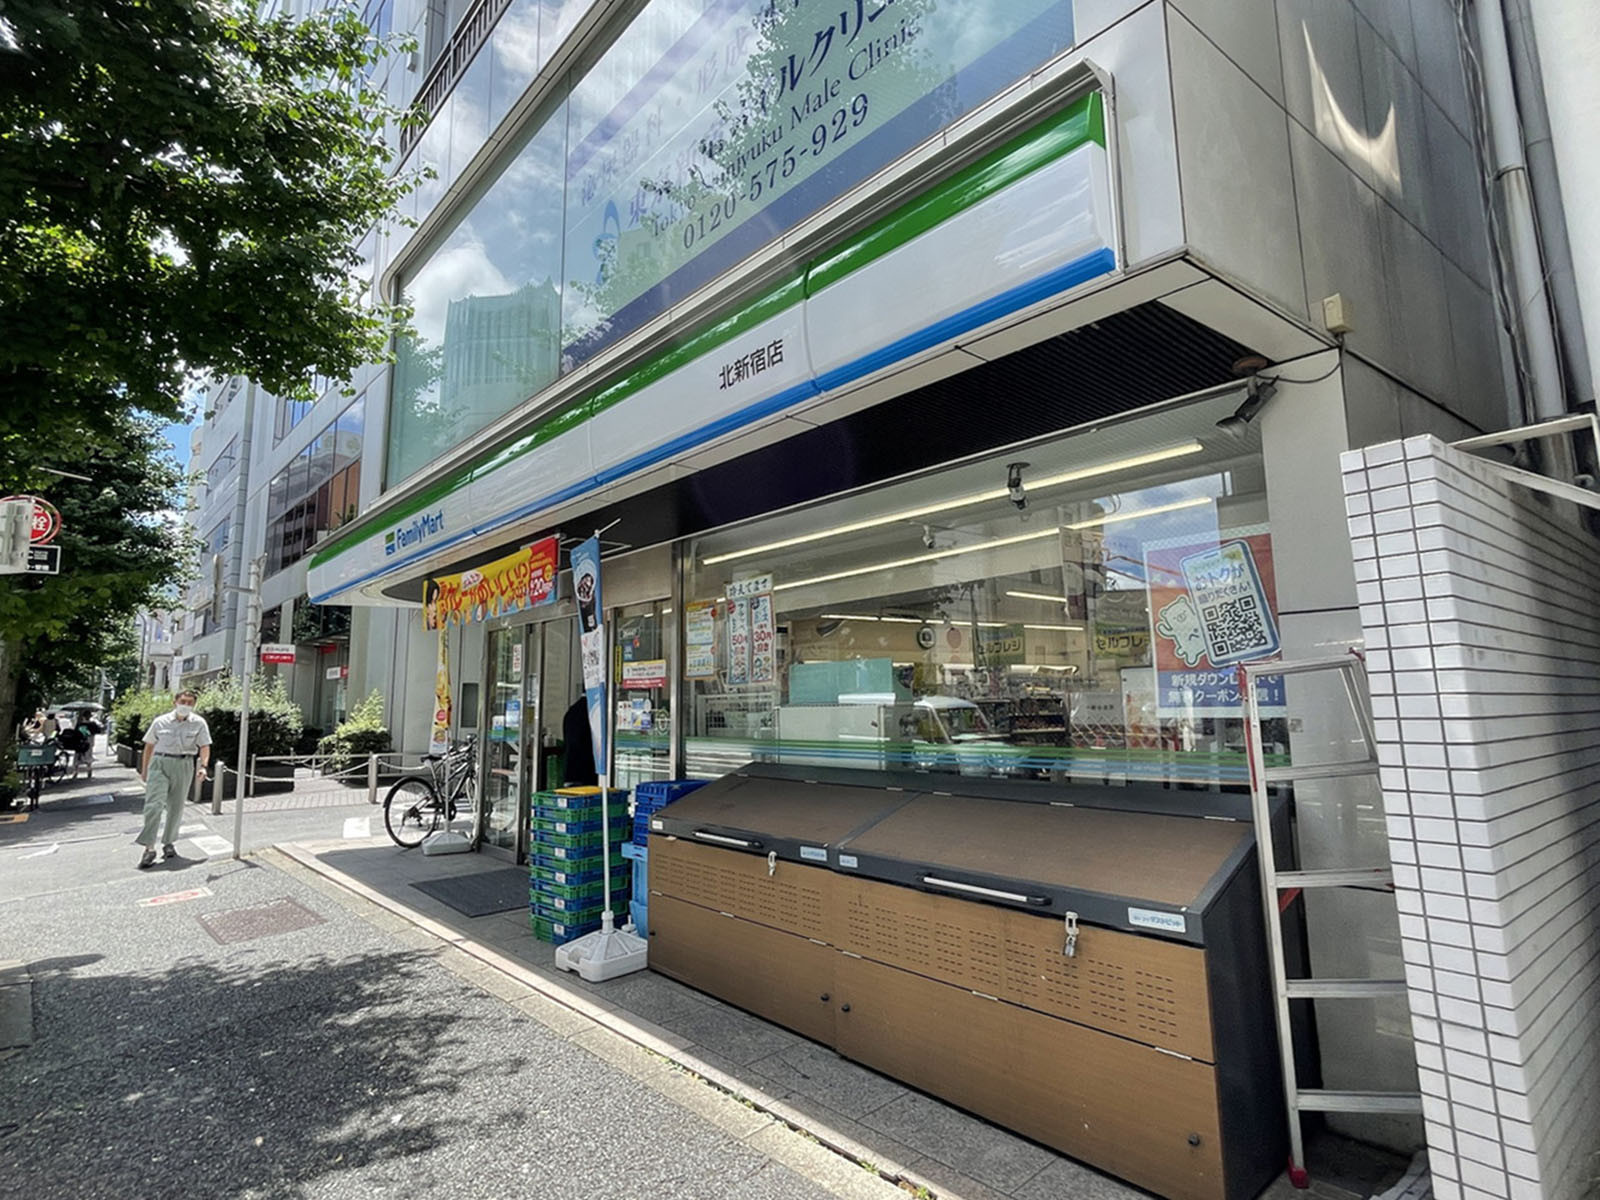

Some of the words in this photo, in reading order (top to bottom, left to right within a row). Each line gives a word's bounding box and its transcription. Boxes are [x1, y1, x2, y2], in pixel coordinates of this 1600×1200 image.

[790, 77, 842, 132] Male
[848, 17, 920, 82] Clinic
[683, 93, 869, 250] 0120-575-929
[719, 339, 783, 390] 北新宿店
[397, 509, 444, 549] FamilyMart
